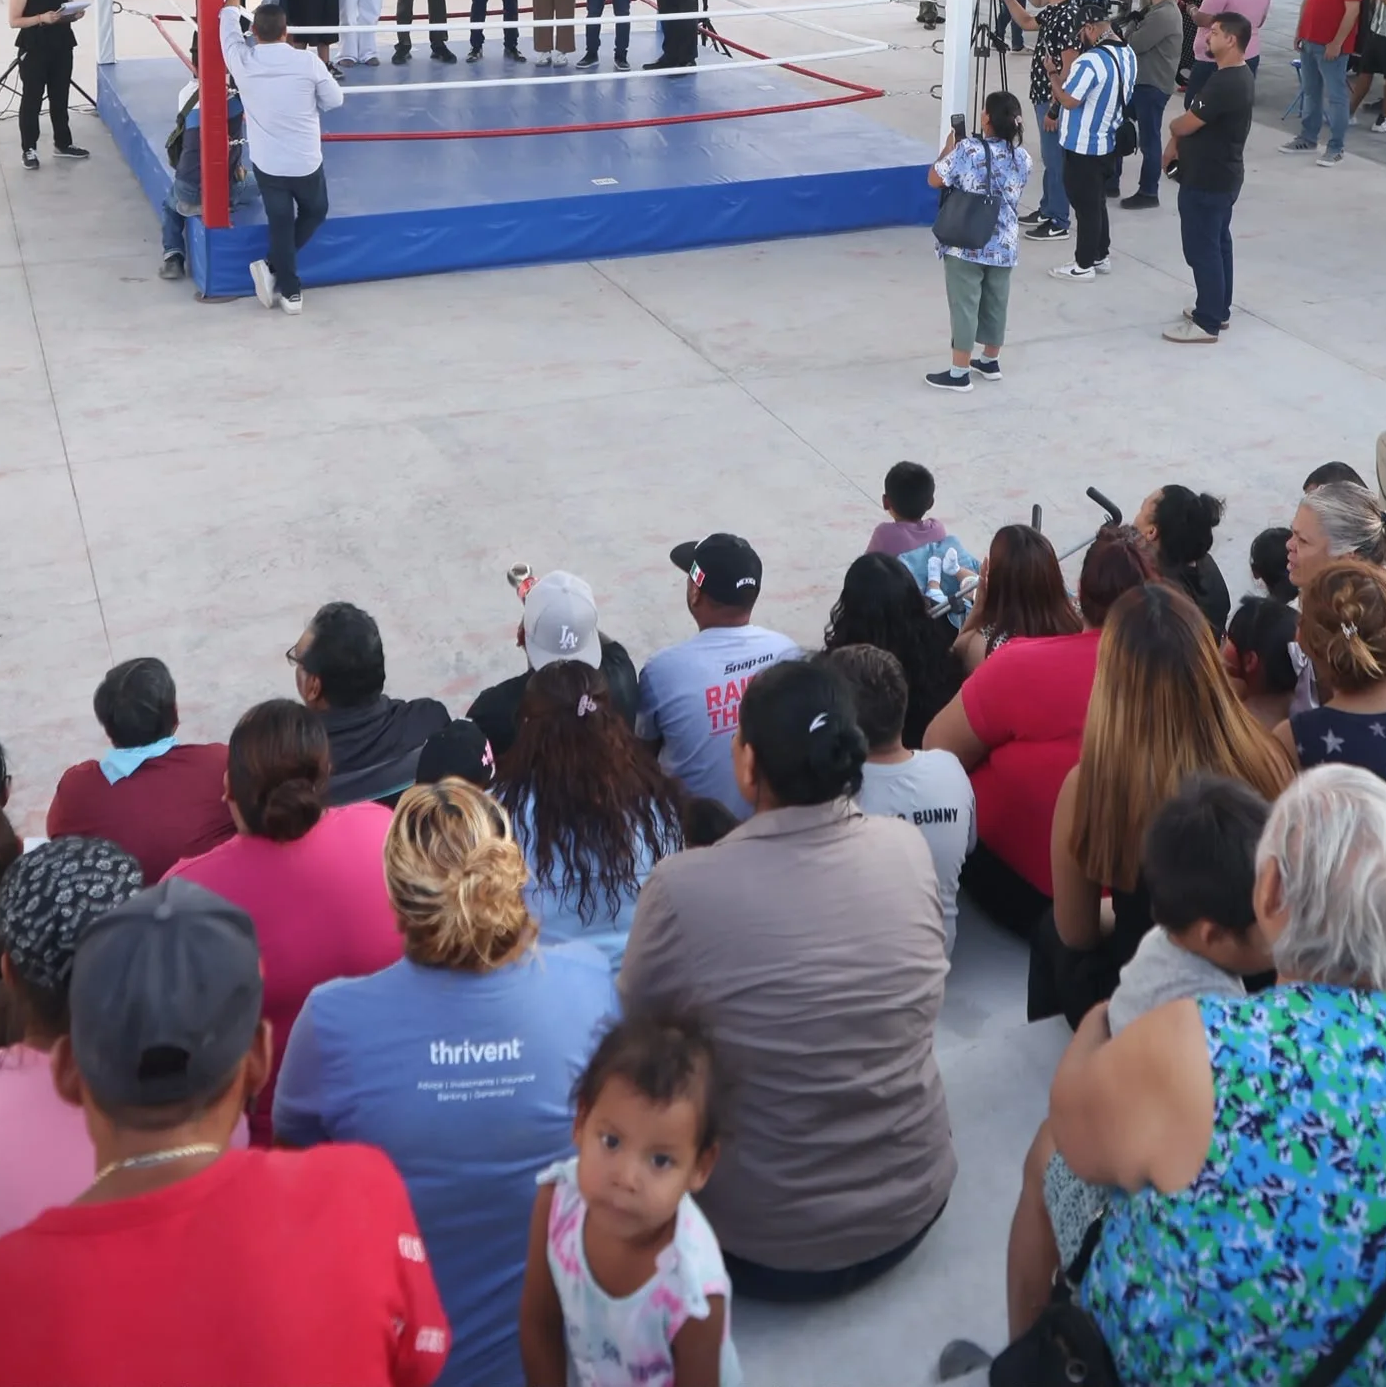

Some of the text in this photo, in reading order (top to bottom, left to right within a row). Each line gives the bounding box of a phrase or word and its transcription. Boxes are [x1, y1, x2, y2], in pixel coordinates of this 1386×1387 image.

[559, 625, 576, 650] LA
[723, 653, 774, 675] Snap-on
[708, 705, 740, 730] TH
[913, 808, 958, 826] BUNNY
[429, 1037, 522, 1065] thrivent
[417, 1080, 443, 1091] Advice
[437, 1091, 468, 1102] Banking
